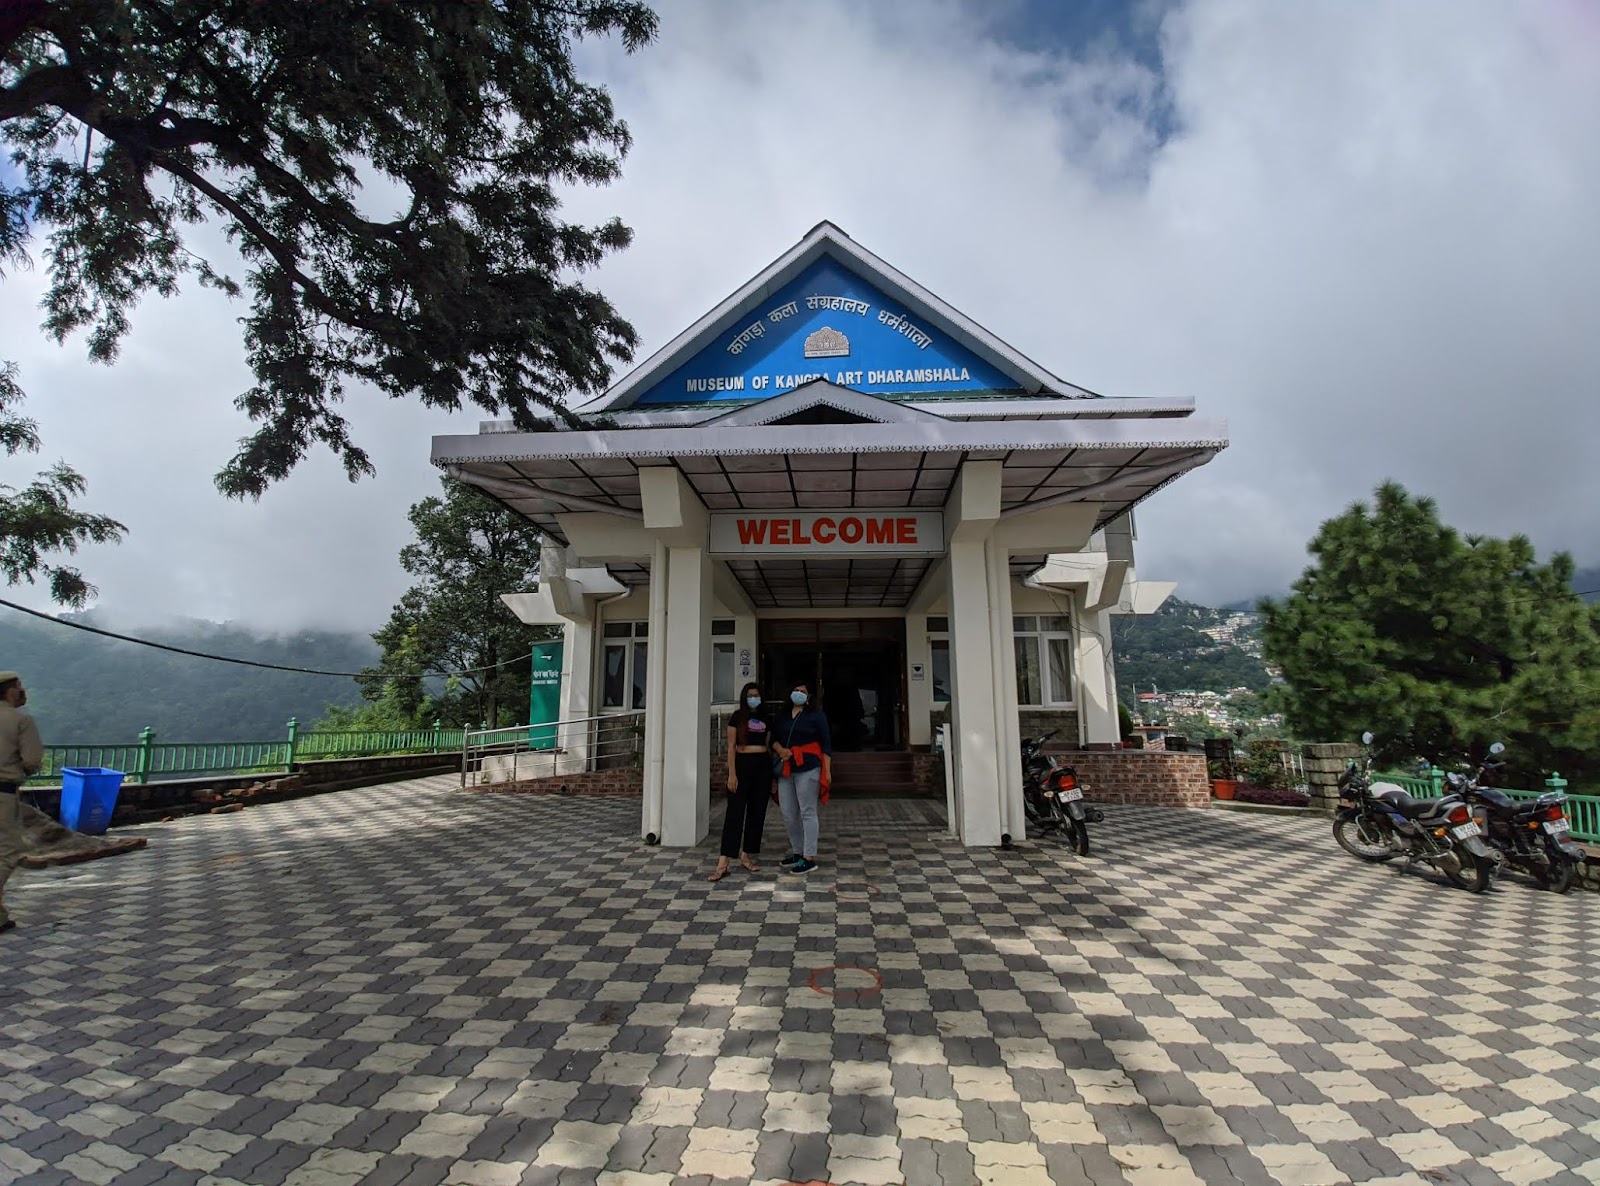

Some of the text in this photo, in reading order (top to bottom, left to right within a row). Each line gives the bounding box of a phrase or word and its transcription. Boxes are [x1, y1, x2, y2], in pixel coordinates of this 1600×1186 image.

[726, 293, 933, 356] कांगड़ा कला संग्रहालय धर्मशाला
[686, 376, 744, 392] MUSEUM
[752, 375, 770, 389] OF
[836, 371, 863, 385] ART
[867, 367, 971, 385] DHARAMSHALA
[736, 517, 918, 545] WELCOME
